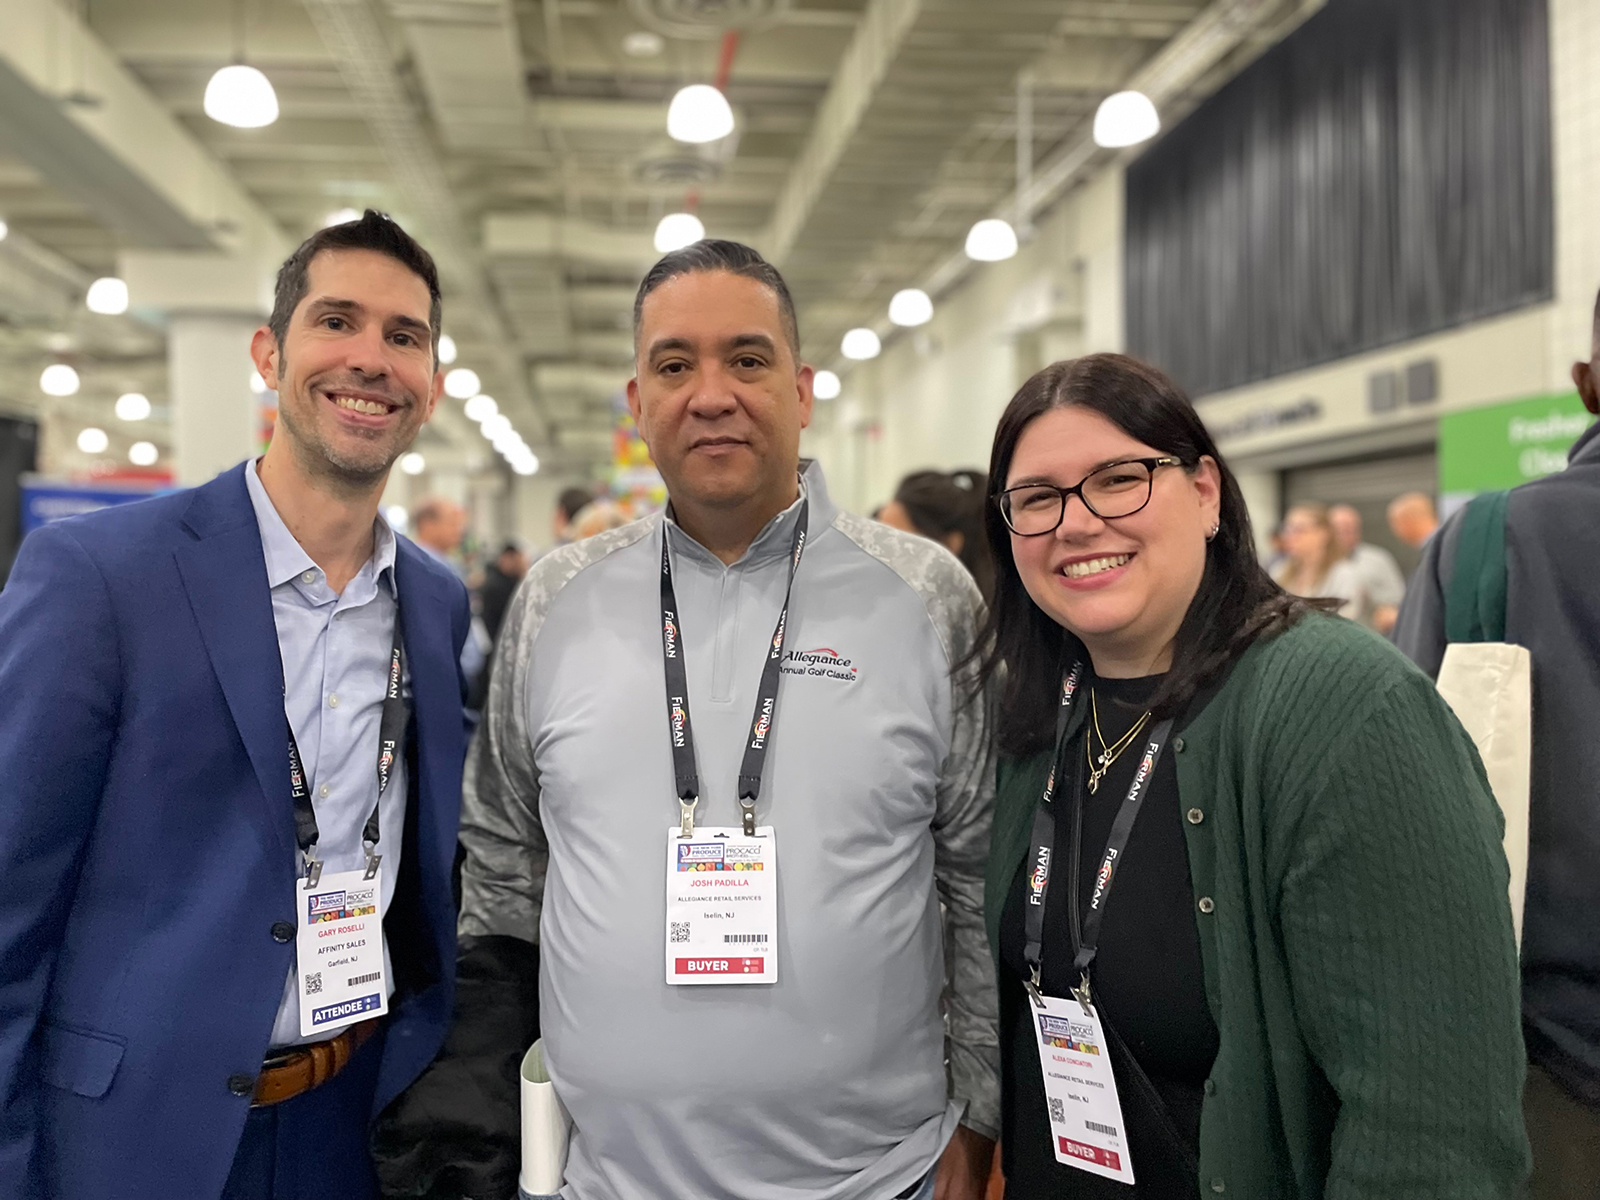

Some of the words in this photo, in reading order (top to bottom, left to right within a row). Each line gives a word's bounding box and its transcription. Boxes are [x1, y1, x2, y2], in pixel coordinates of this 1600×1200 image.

[664, 610, 676, 658] FIERMAN
[388, 648, 400, 699] FIERMAN
[780, 650, 851, 667] Allegiance
[808, 667, 826, 677] Golf
[826, 670, 856, 681] Classic
[671, 696, 685, 747] FIERMAN
[752, 698, 774, 749] FIERMAN
[288, 741, 305, 798] FIERMAN
[1127, 742, 1159, 801] FIERMAN
[714, 879, 749, 887] PADILLA
[1030, 846, 1050, 906] FIERMAN
[1091, 847, 1118, 910] FIERMAN
[318, 928, 336, 938] GARY
[338, 923, 365, 934] ROSELLI
[318, 943, 345, 955] AFFINITY
[346, 939, 366, 949] SALES
[687, 960, 729, 971] BUYER
[314, 1000, 363, 1022] ATTENDEE
[1066, 1140, 1095, 1160] BUYER
